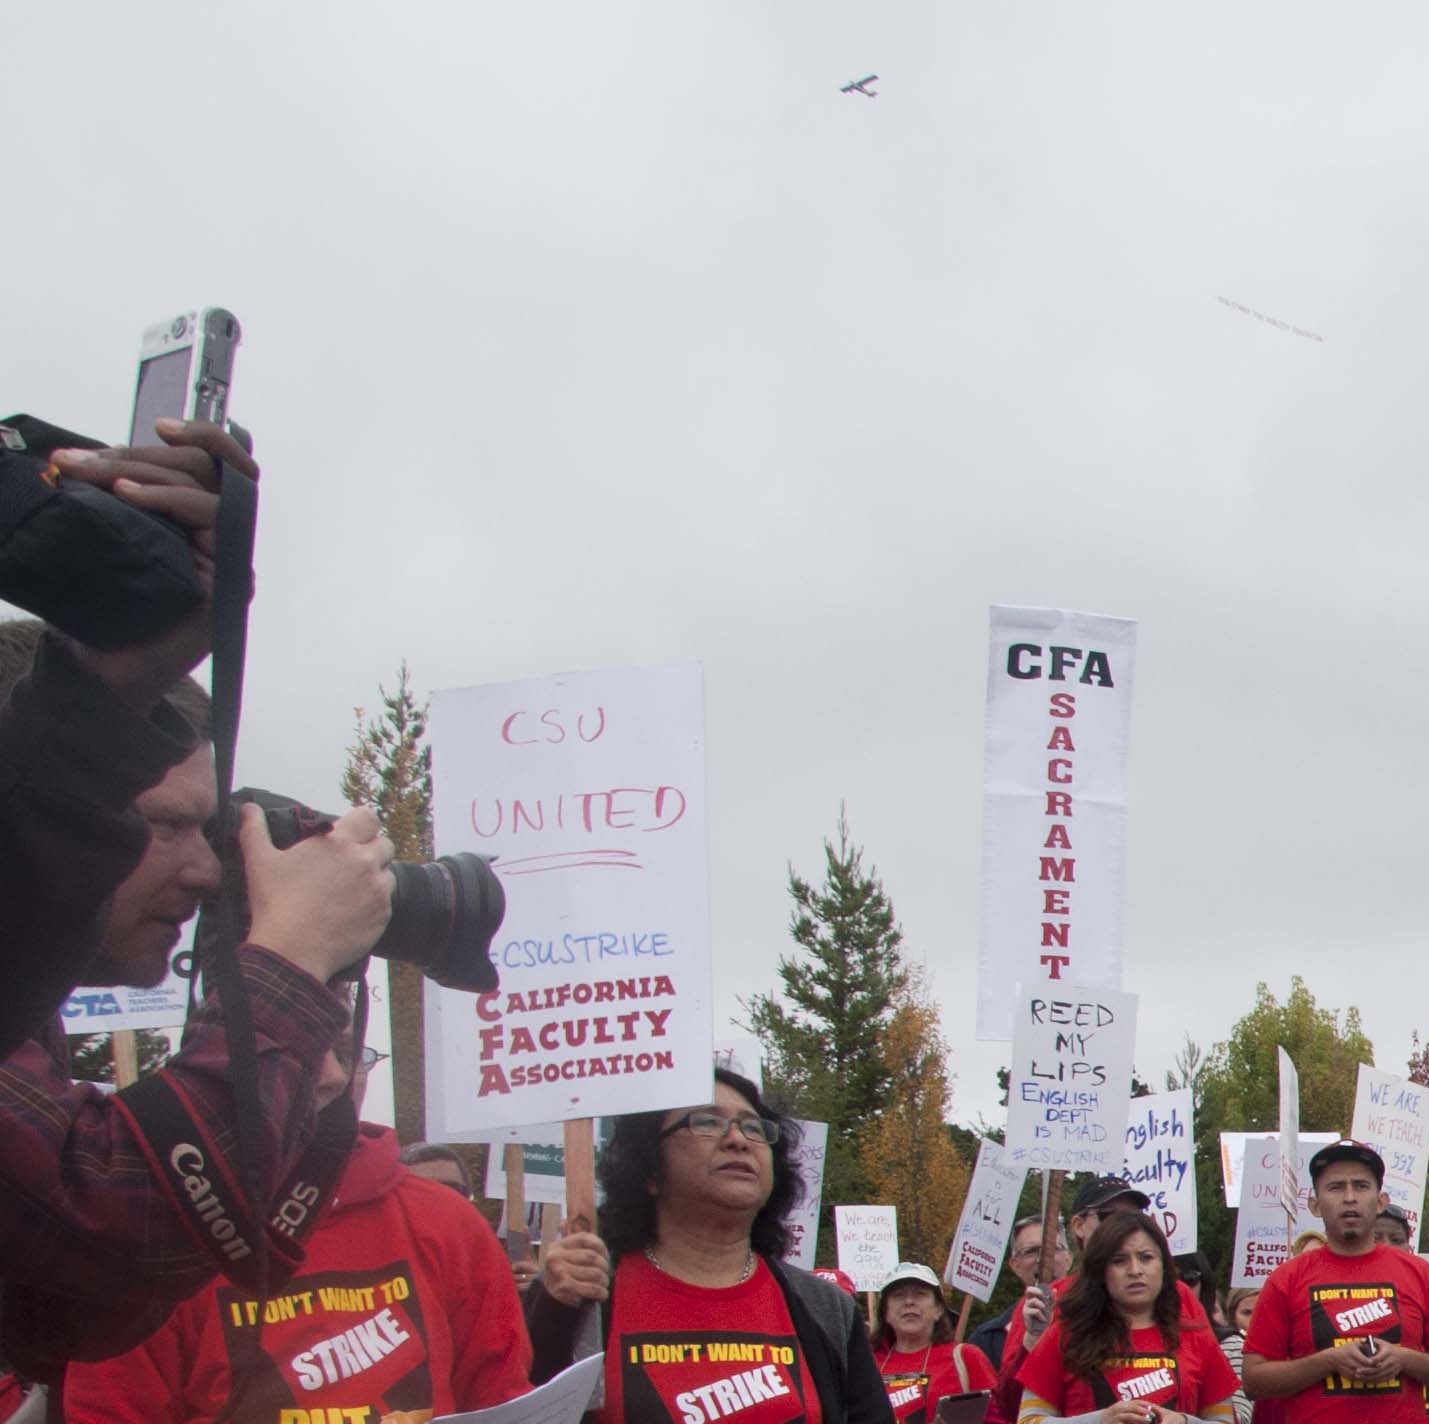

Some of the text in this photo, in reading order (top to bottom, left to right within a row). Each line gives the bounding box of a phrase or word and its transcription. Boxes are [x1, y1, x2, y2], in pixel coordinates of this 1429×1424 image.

[1006, 643, 1114, 688] CFA
[501, 707, 605, 744] CSU
[471, 786, 686, 837] UNITED
[1038, 692, 1076, 979] SACRAMENT
[59, 994, 122, 1018] CTA
[475, 975, 677, 1022] CALIFORNIA
[1031, 999, 1114, 1027] REED
[478, 1009, 673, 1060] FACULTY
[1056, 1031, 1094, 1056] MY
[477, 1050, 675, 1097] ASSOCIATION
[1031, 1060, 1107, 1086] LIPS
[1021, 1082, 1099, 1107] ENGLISH
[1369, 1081, 1391, 1107] WE
[1045, 1108, 1093, 1124] DEPT
[1064, 1124, 1107, 1142] MAD
[1125, 1109, 1184, 1149] nglish
[1121, 1149, 1188, 1191] aculty
[170, 1143, 251, 1261] Canon
[271, 1181, 320, 1237] EOS
[1246, 1241, 1287, 1252] CALIFO
[959, 1253, 993, 1278] FACULTY
[232, 1303, 242, 1326] I
[319, 1287, 375, 1312] WANT
[384, 1277, 410, 1301] TO
[1314, 1288, 1393, 1301] I DON'T WANT TO
[1335, 1298, 1393, 1332] STRIKE
[291, 1308, 410, 1391] STRIKE
[630, 1343, 794, 1365] I DON'T WANT TO
[1132, 1357, 1176, 1369] WANT TO
[888, 1385, 921, 1408] RIKE
[1117, 1367, 1174, 1401] STRIKE
